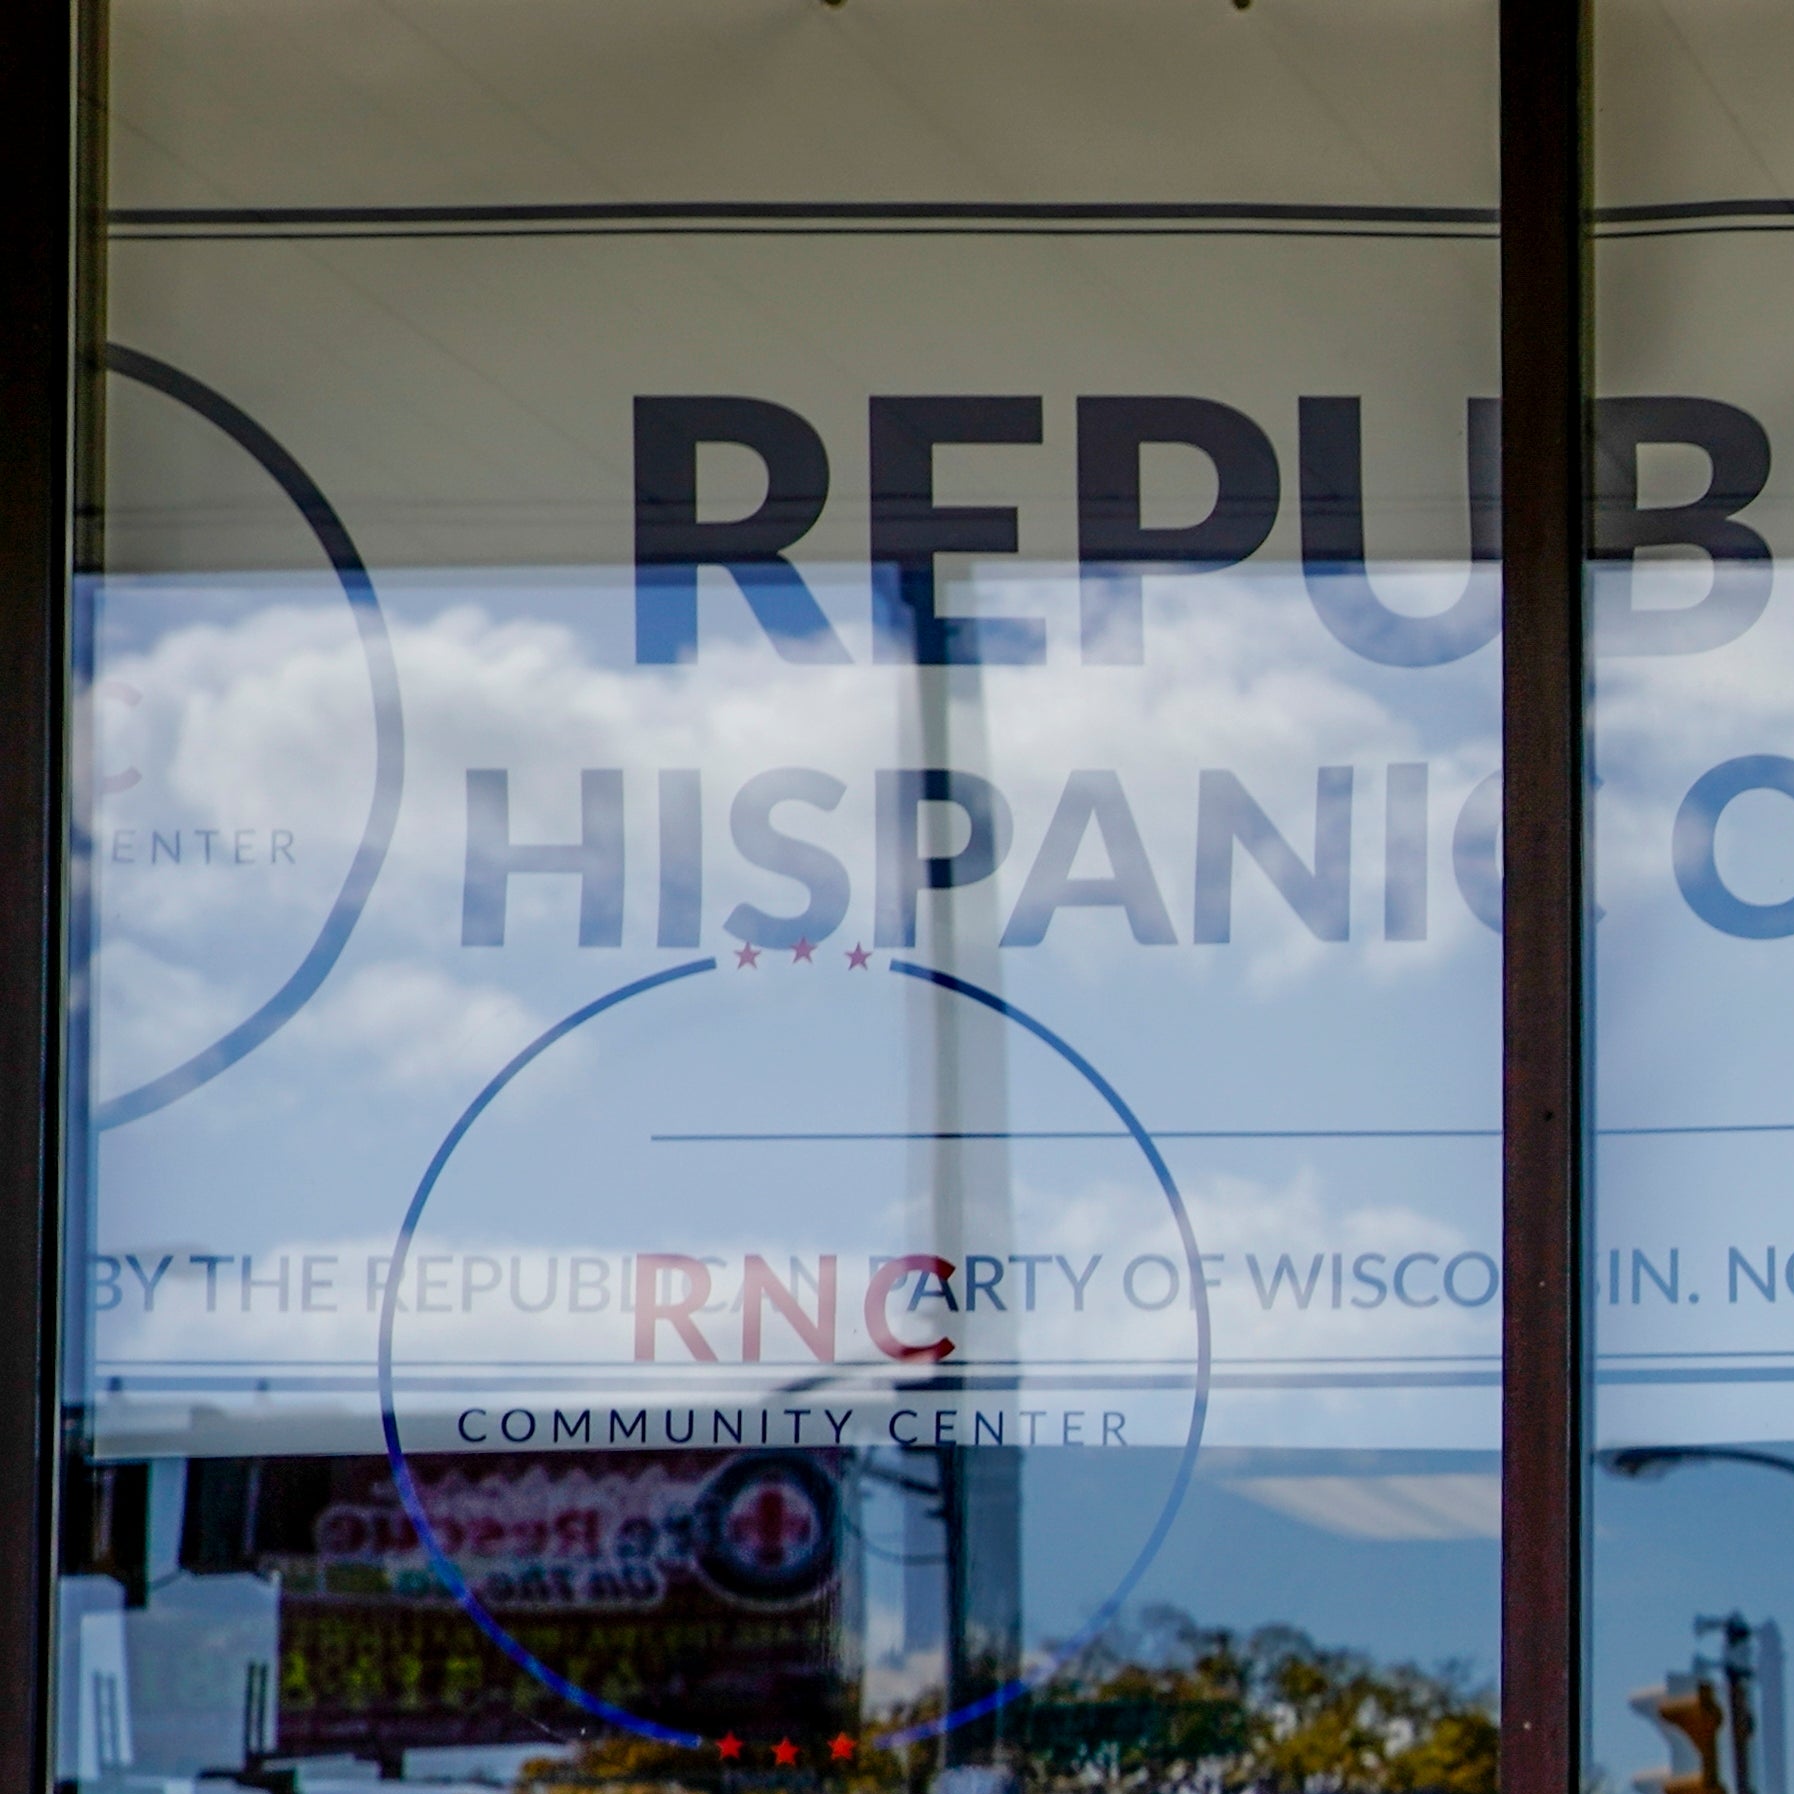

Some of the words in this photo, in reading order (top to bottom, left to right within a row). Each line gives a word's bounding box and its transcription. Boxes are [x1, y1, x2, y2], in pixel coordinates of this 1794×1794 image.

[109, 828, 297, 866] ENTER
[188, 1253, 339, 1313] THE
[366, 1253, 821, 1315] REPUBLICAN
[867, 1253, 1103, 1313] PARTY
[1121, 1252, 1223, 1312] OF
[1243, 1247, 1702, 1310] WISCOIN.
[633, 1252, 958, 1364] RNC
[457, 1408, 853, 1446] COMMUNITY
[888, 1408, 1130, 1447] CENTER
